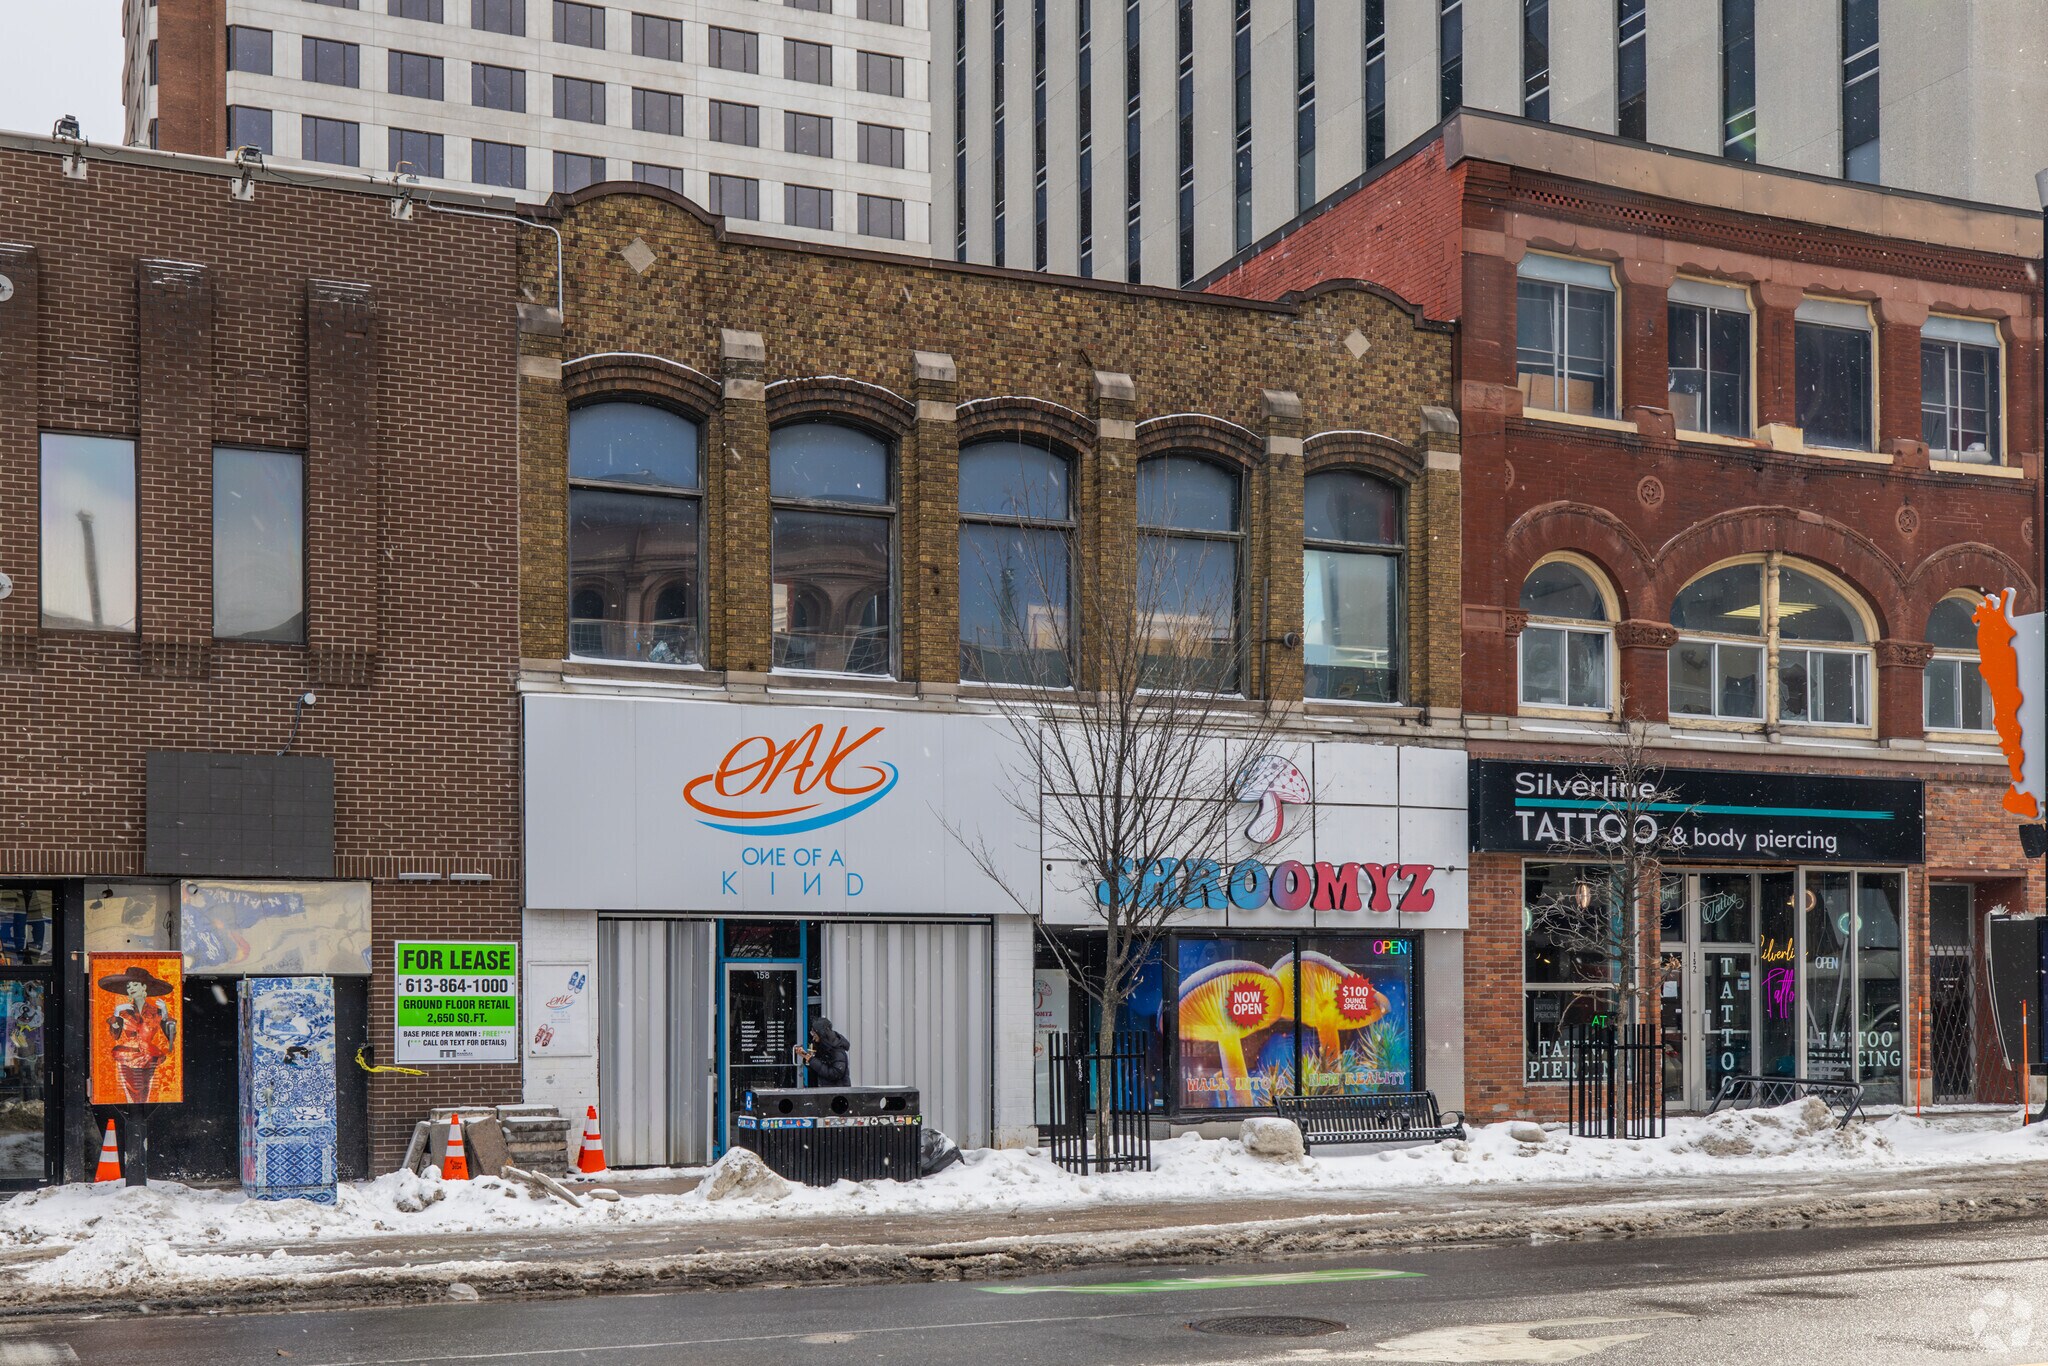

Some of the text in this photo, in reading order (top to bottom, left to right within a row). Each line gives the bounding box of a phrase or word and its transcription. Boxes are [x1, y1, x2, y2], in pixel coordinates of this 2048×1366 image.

[684, 724, 888, 819] OAK
[1515, 772, 1656, 799] Silverline
[1515, 810, 1837, 853] TATTOO & body piercing
[794, 848, 822, 867] OF
[828, 848, 844, 867] A
[1097, 858, 1435, 912] SHROOMYZ
[1373, 940, 1408, 955] OPEN
[403, 950, 511, 970] FOR LEASE
[1815, 956, 1839, 969] OPEN
[756, 971, 770, 980] 158
[405, 978, 508, 993] 613-864-1000
[1342, 986, 1369, 997] $100
[403, 1000, 511, 1009] GROUND FLOOR RETAIL
[1234, 992, 1261, 1004] NOW
[1233, 1004, 1263, 1015] OPEN
[427, 1013, 488, 1024] 2,650 SQ.FT.
[1187, 1071, 1406, 1091] WALK INTO A NEW REALITY
